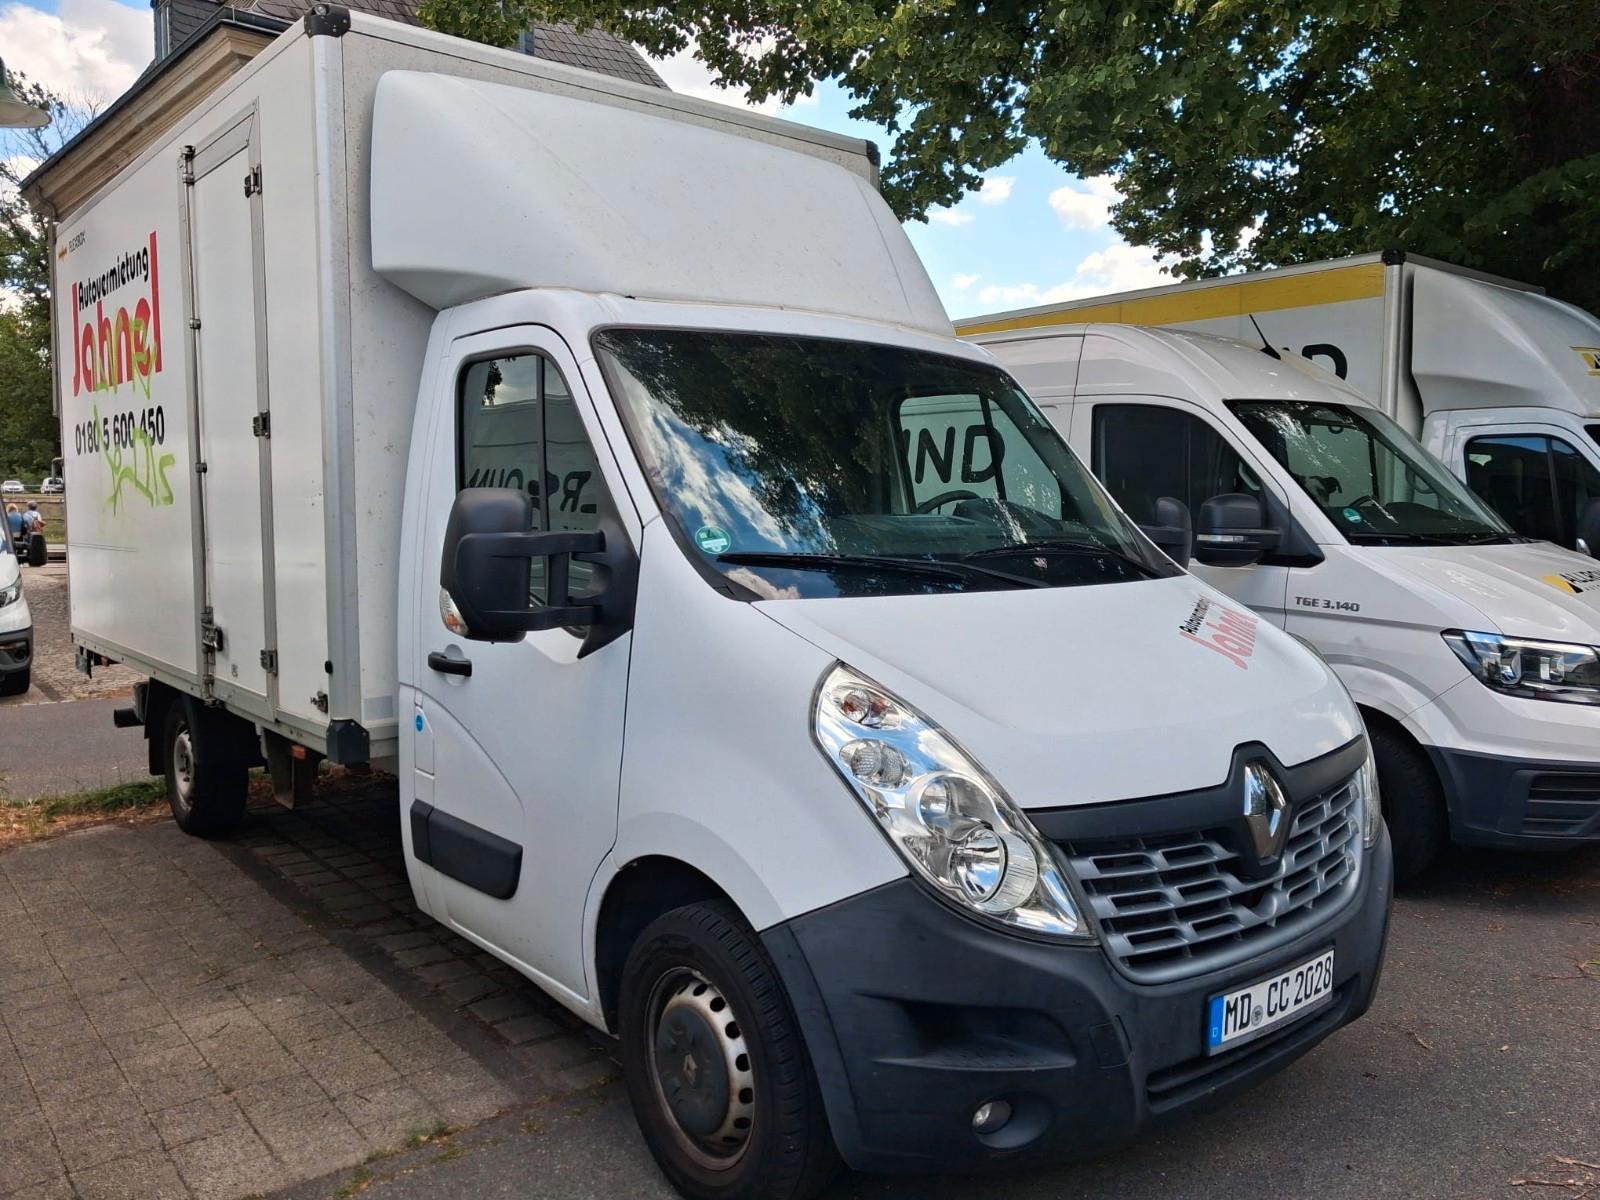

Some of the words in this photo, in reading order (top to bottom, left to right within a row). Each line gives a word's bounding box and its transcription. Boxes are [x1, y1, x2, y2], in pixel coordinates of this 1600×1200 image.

[78, 247, 149, 310] Autovermietung
[72, 230, 162, 397] Jahnel
[75, 419, 100, 456] 0180
[103, 417, 110, 451] 5
[113, 411, 135, 450] 600
[1322, 599, 1360, 612] 3.140
[1225, 993, 1252, 1035] MD
[1267, 976, 1290, 1017] CC
[1294, 956, 1331, 1006] 2028
